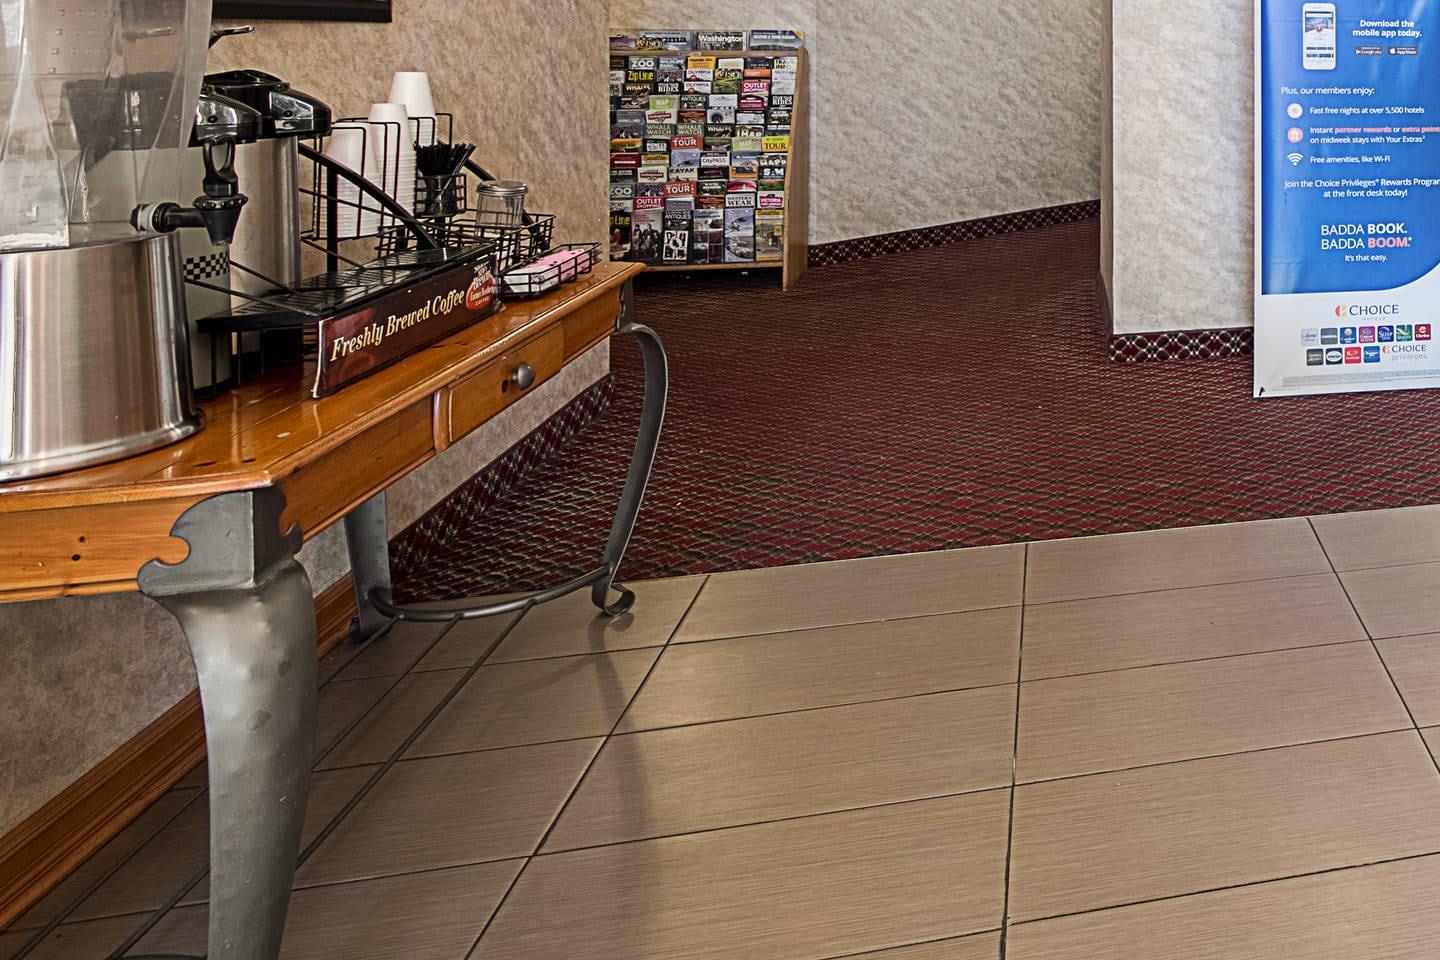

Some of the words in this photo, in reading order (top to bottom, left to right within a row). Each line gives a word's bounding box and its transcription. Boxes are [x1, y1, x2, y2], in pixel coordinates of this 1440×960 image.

[1381, 30, 1396, 38] app
[1398, 30, 1422, 38] today.
[1281, 86, 1299, 94] Plus,
[1352, 87, 1375, 96] enjoy:
[1339, 107, 1360, 115] nights
[1334, 126, 1362, 134] partner
[1352, 136, 1370, 144] stays
[764, 142, 786, 150] TOUR
[1326, 156, 1360, 164] amenities,
[1284, 180, 1300, 189] Join
[1314, 179, 1340, 188] Choice
[1346, 190, 1364, 198] front
[1384, 189, 1408, 198] today!
[1321, 224, 1364, 236] BADDA
[1368, 223, 1408, 234] BOOK.
[1321, 238, 1365, 250] BADDA
[1349, 304, 1400, 316] CHOICE
[330, 322, 384, 362] Freshly
[385, 300, 430, 337] Brewed
[432, 289, 465, 315] Coffee
[1392, 344, 1426, 353] CHOICE
